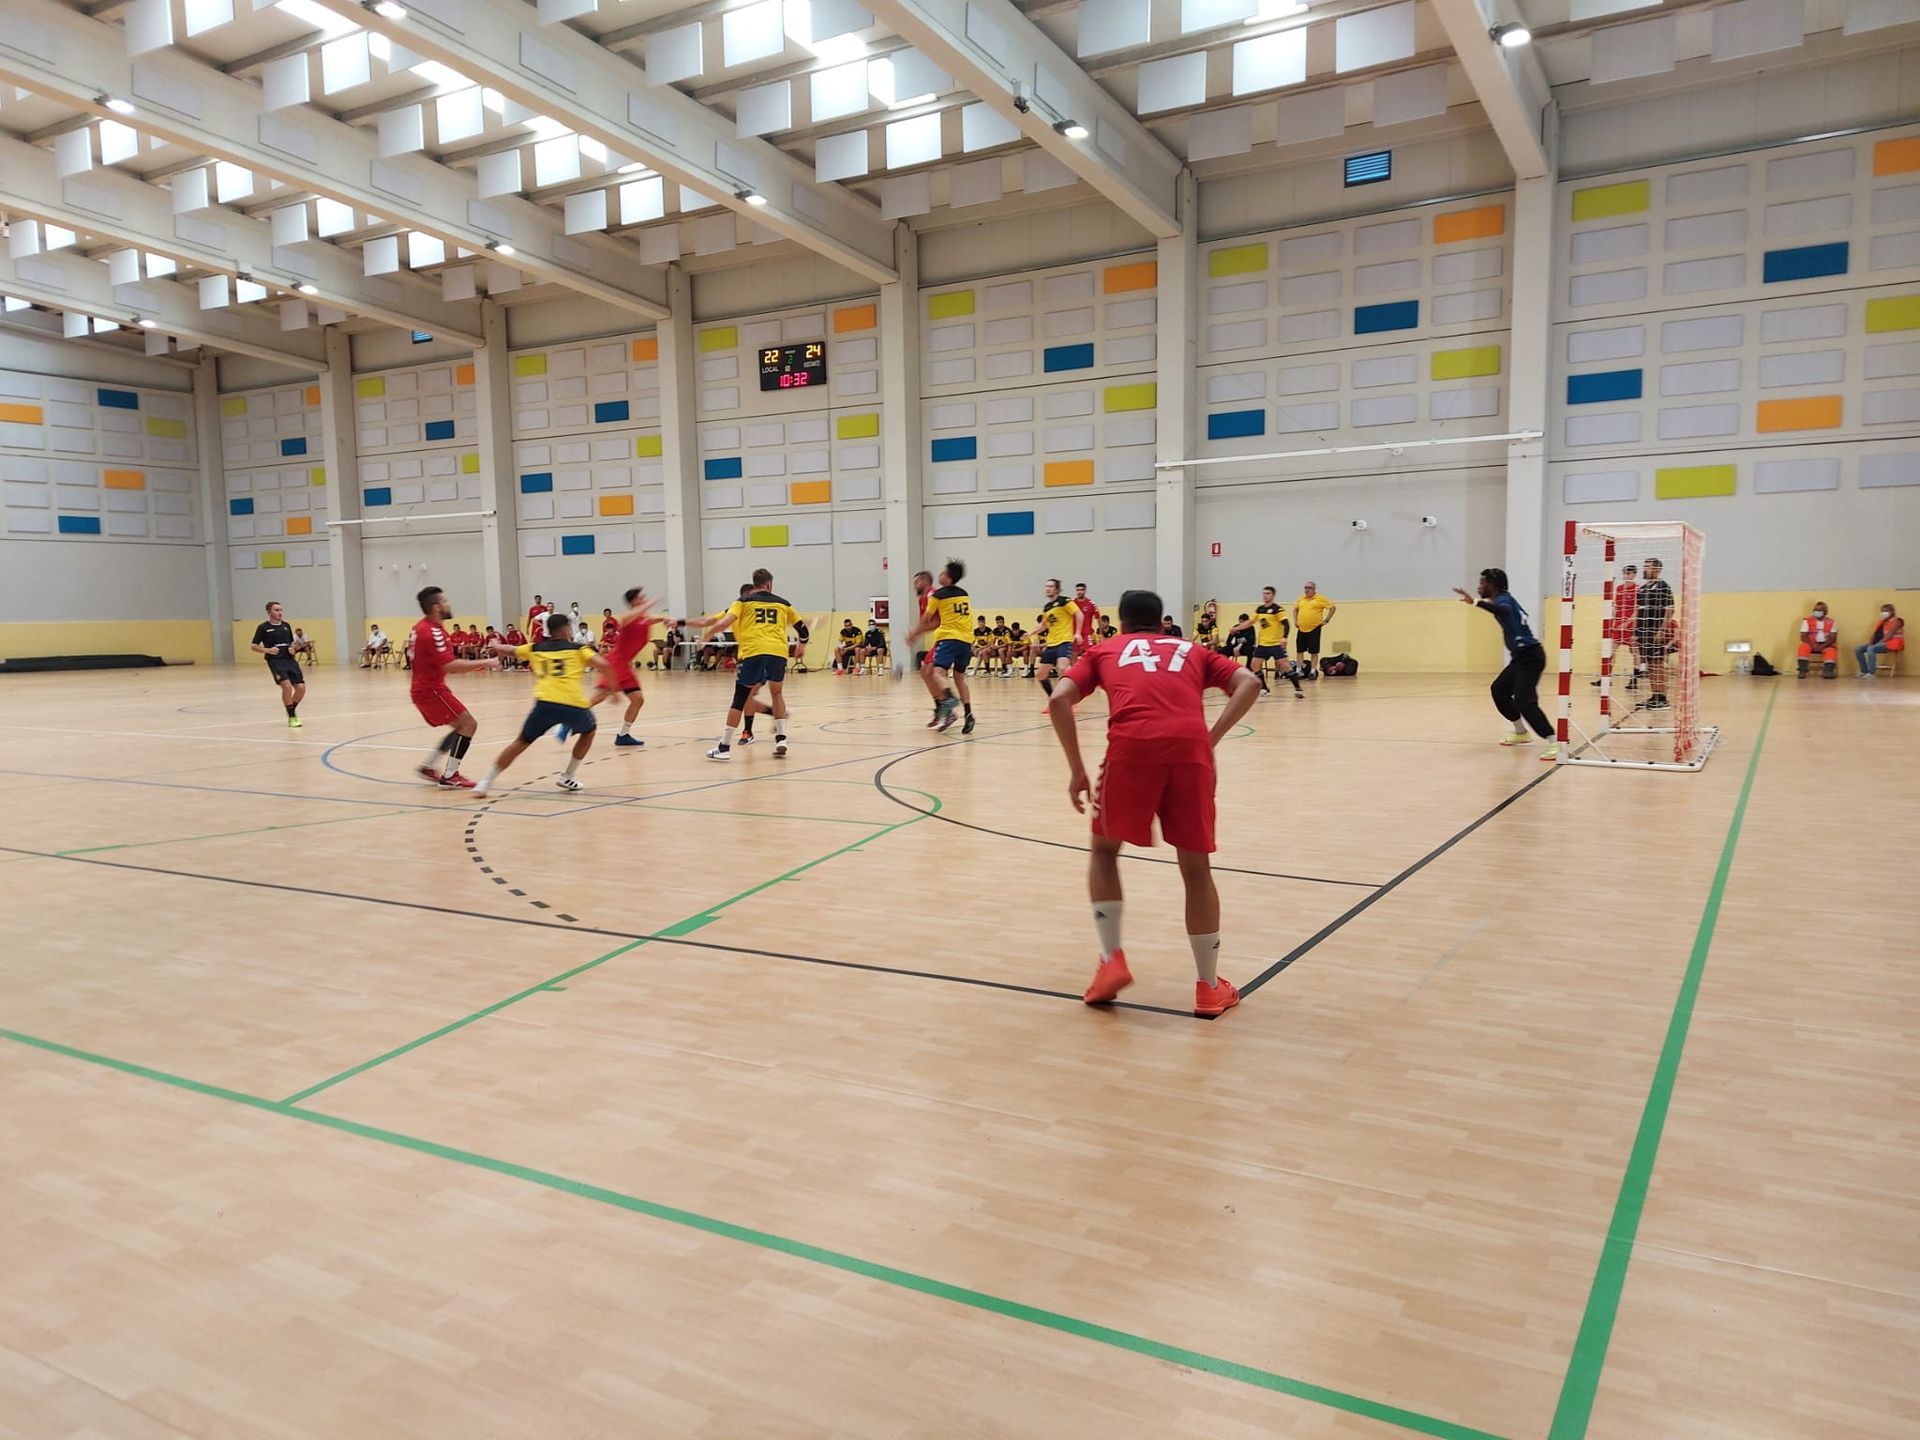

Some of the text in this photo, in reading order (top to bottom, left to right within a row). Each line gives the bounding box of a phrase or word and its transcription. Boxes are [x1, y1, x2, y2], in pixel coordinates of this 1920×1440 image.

[764, 350, 779, 363] 22
[805, 345, 821, 358] 24
[780, 372, 808, 387] 10:32
[755, 608, 777, 624] 39
[954, 602, 969, 616] 42
[1118, 638, 1193, 672] 47
